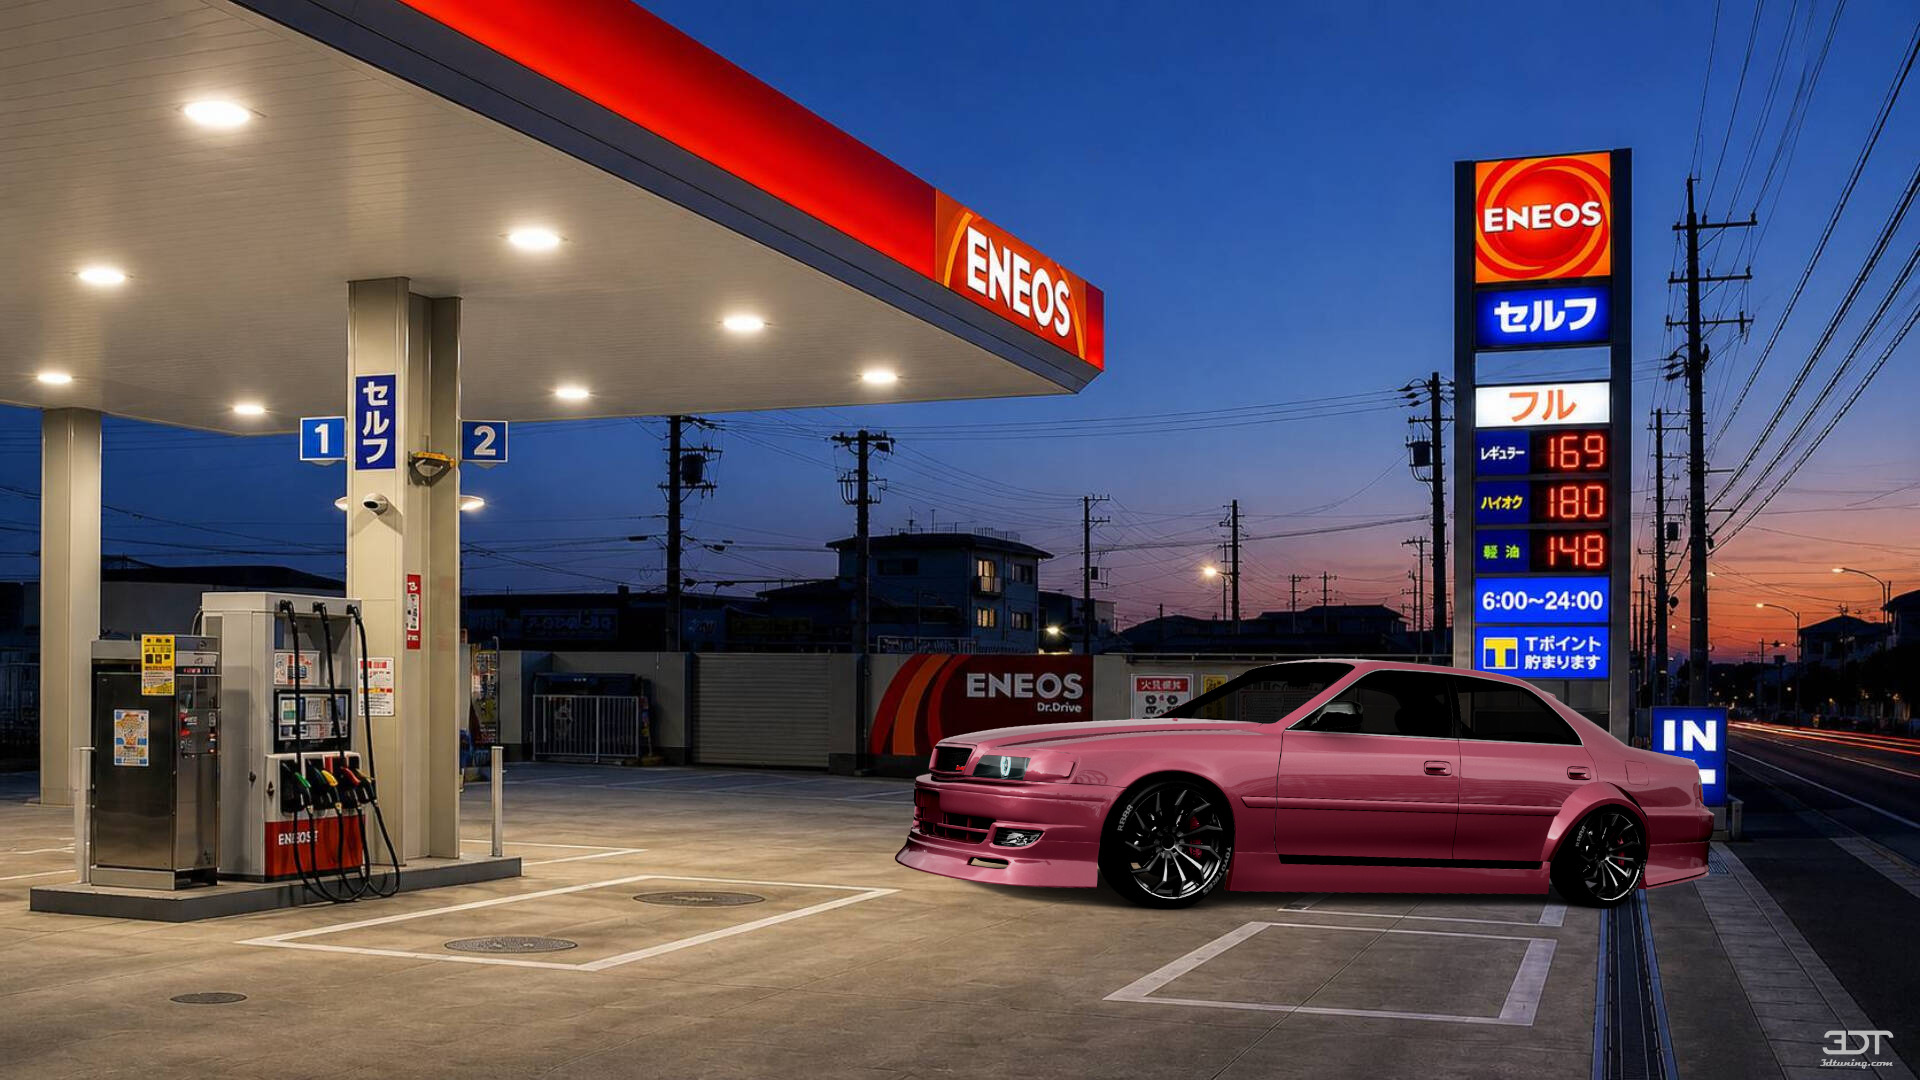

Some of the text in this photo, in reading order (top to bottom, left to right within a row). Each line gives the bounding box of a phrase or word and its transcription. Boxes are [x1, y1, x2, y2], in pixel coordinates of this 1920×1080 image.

[1485, 202, 1602, 232] ENEOS
[967, 226, 1070, 337] ENEOS
[1493, 297, 1597, 333] セルフ
[1509, 388, 1577, 422] フル
[314, 423, 329, 454] 1
[362, 381, 390, 464] セルフ
[473, 424, 497, 457] 2
[1480, 434, 1605, 469] レギュラー 169
[1480, 484, 1605, 519] ハイオク 180
[1548, 533, 1604, 567] 148
[1524, 636, 1602, 653] Tポイント
[1524, 654, 1602, 670] 貯まります
[966, 672, 1083, 699] ENEOS
[1037, 702, 1082, 713] Dr.Drive
[1663, 719, 1717, 752] IN
